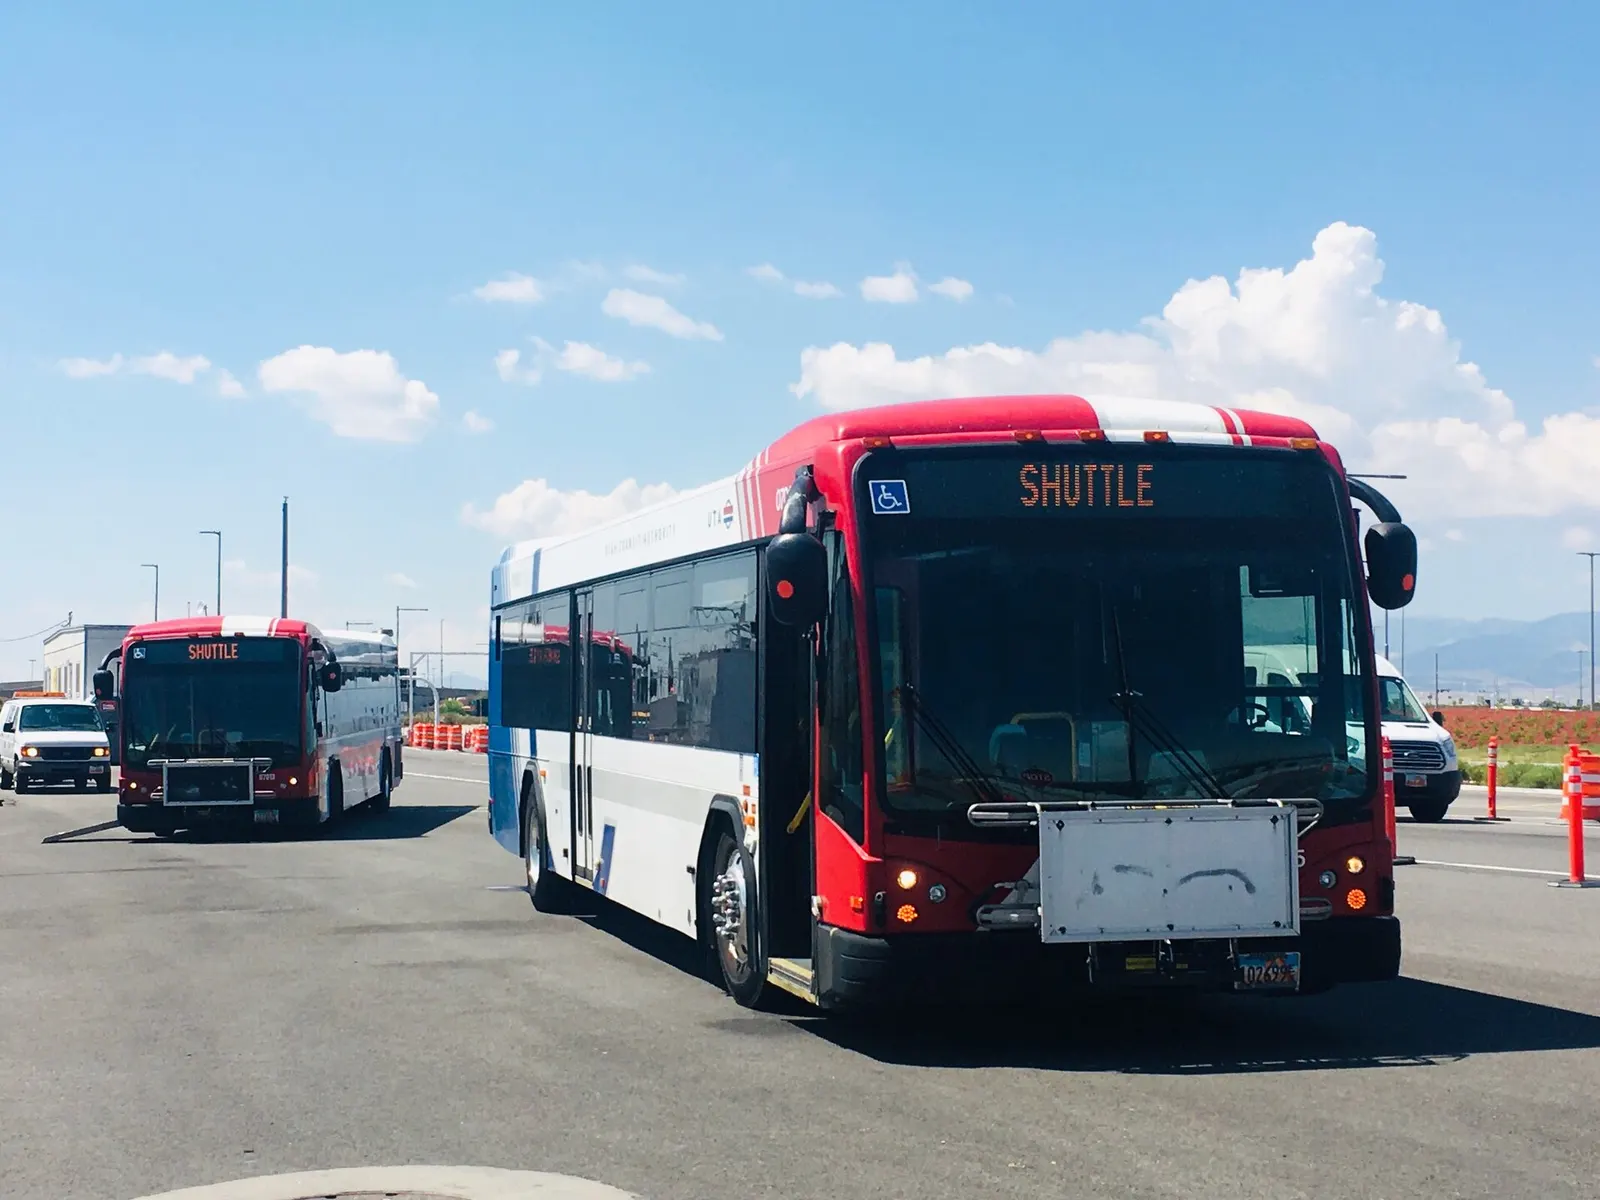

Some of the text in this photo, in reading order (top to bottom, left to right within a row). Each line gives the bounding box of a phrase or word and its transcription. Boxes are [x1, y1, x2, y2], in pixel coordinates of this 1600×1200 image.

[1019, 464, 1154, 507] SHUTTLE
[707, 509, 722, 529] UTA
[188, 643, 239, 660] SHUTTLE
